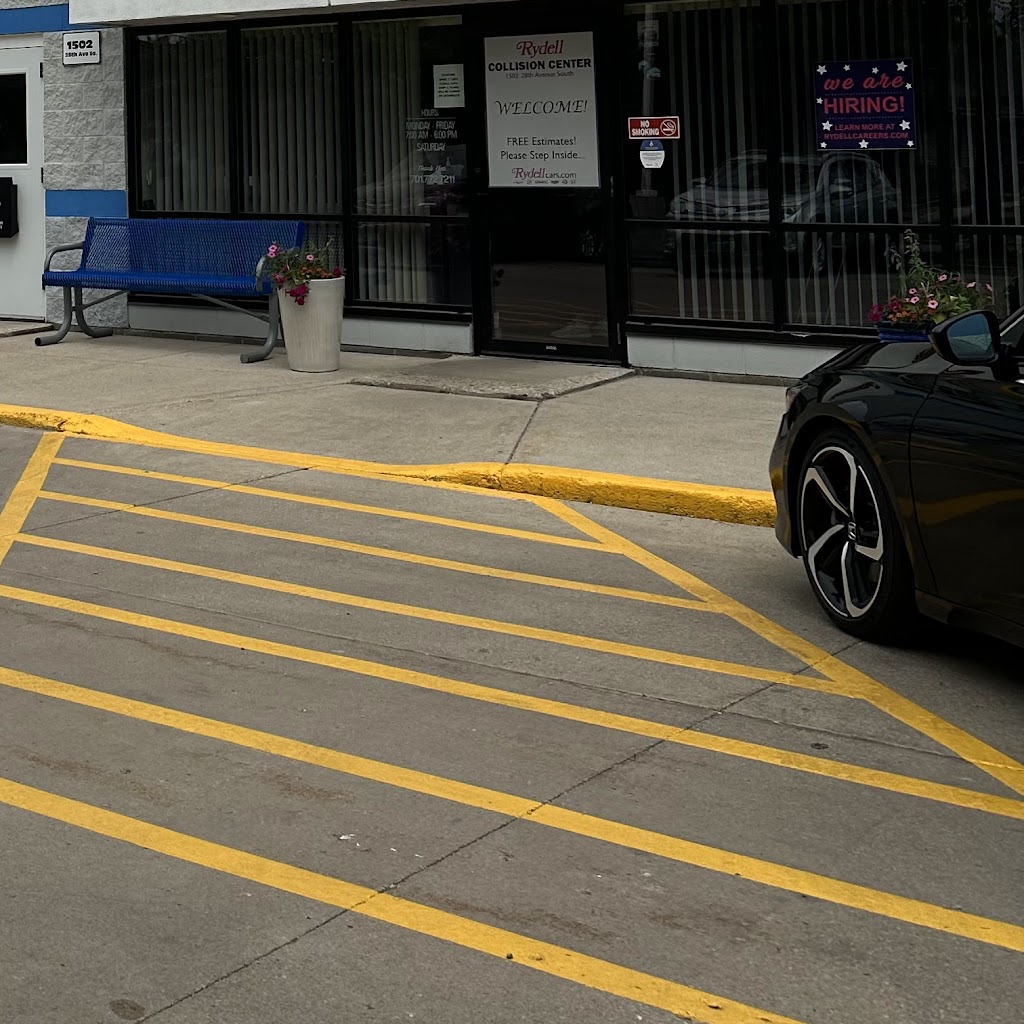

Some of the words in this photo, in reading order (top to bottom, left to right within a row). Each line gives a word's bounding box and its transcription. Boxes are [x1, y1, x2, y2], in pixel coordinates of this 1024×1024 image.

[67, 39, 93, 50] 1502
[516, 39, 564, 59] Rydell
[488, 60, 545, 72] COLLISION
[548, 58, 592, 69] CENTER
[823, 76, 855, 90] we
[862, 72, 905, 89] are
[495, 99, 588, 115] WELCOME!
[823, 95, 905, 114] HIRING!
[406, 121, 431, 130] MONDAY
[436, 120, 456, 130] FRIDAY
[640, 119, 650, 128] NO
[418, 130, 429, 139] AM
[447, 130, 458, 139] PM
[631, 128, 660, 136] SMOKING
[824, 132, 909, 140] RYDELLCAREERS.COM
[507, 137, 529, 146] FREE
[532, 136, 577, 146] Estimates!
[417, 142, 446, 151] SATURDAY
[500, 151, 527, 160] Please
[530, 151, 549, 161] Step
